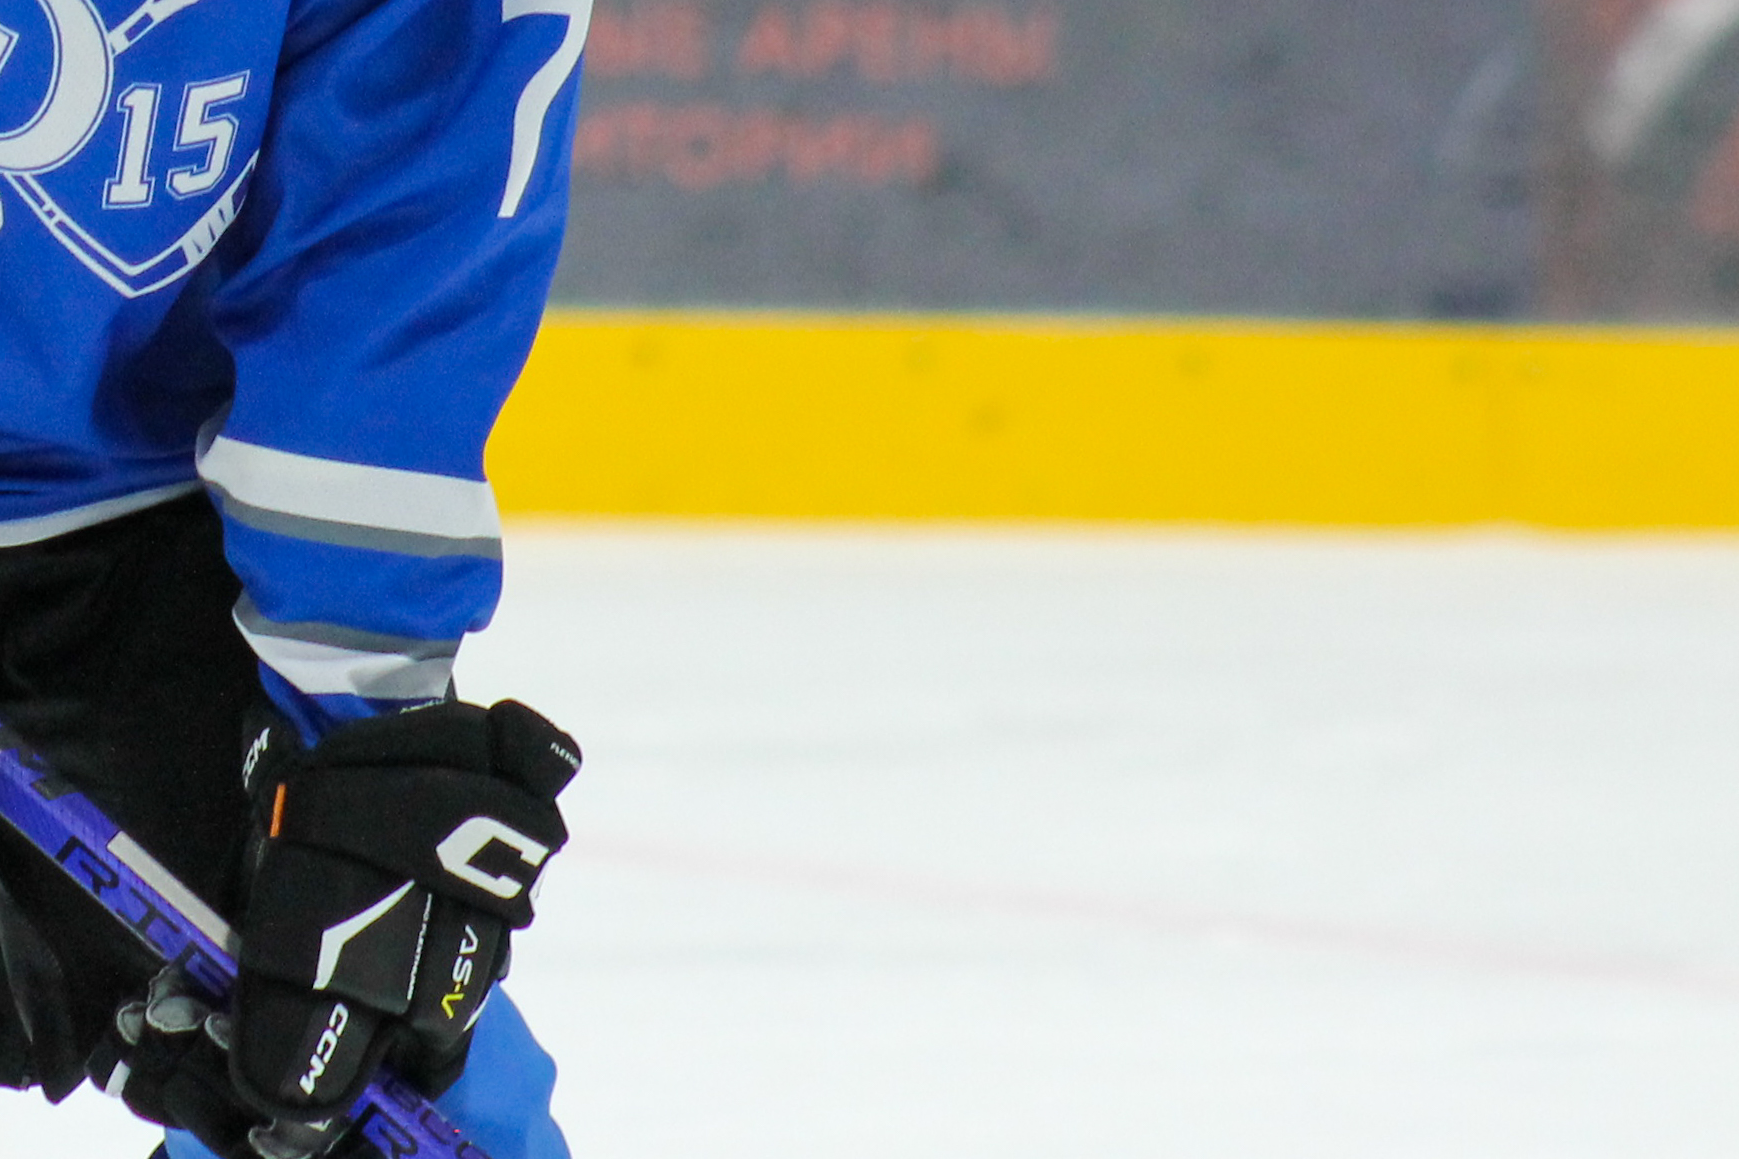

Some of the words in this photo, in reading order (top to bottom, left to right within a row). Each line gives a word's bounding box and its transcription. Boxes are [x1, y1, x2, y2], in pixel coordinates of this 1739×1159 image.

[102, 69, 252, 211] 15
[440, 924, 480, 1020] AS-V
[299, 1002, 349, 1096] CCM
